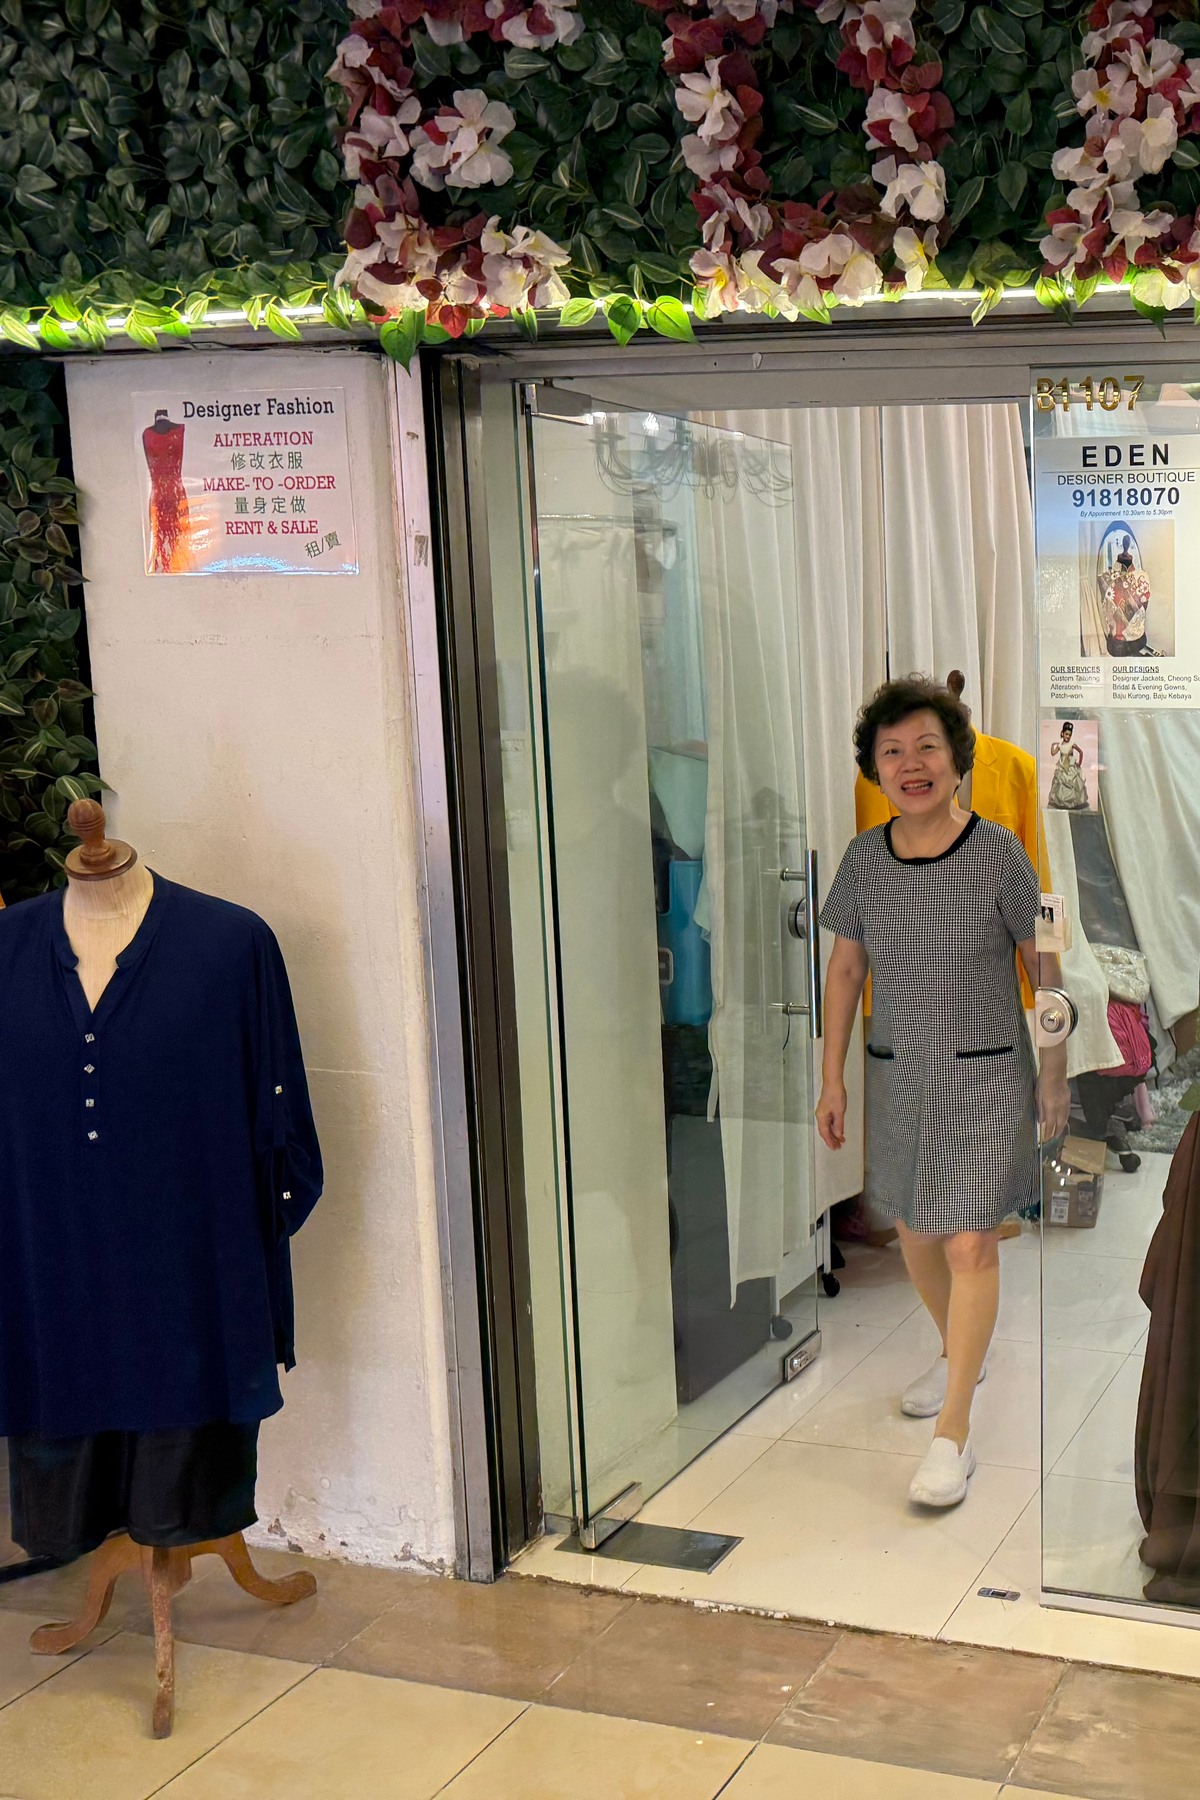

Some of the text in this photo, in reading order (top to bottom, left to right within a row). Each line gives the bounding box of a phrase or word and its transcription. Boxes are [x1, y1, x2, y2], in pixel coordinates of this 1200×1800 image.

[1036, 375, 1145, 412] B1107
[183, 396, 335, 421] Designer Fashion
[213, 431, 313, 447] ALTERATION
[230, 451, 303, 471] 修改衣服
[1082, 443, 1169, 468] EDEN
[203, 475, 336, 492] MAKE- TO -ORDER
[1057, 471, 1196, 486] DESIGNER BOUTIQUE
[234, 496, 306, 514] 量身定做
[1072, 486, 1180, 508] 91818070
[225, 520, 318, 535] RENT & SALE
[1112, 675, 1139, 683] Designer
[1140, 675, 1166, 683] Jackets,
[1167, 675, 1192, 683] Cheong
[1112, 692, 1126, 700] Baju
[1153, 692, 1167, 700] Baju
[1168, 692, 1192, 700] Kebaya
[1137, 684, 1163, 692] Evening
[1164, 684, 1187, 692] Gowns,
